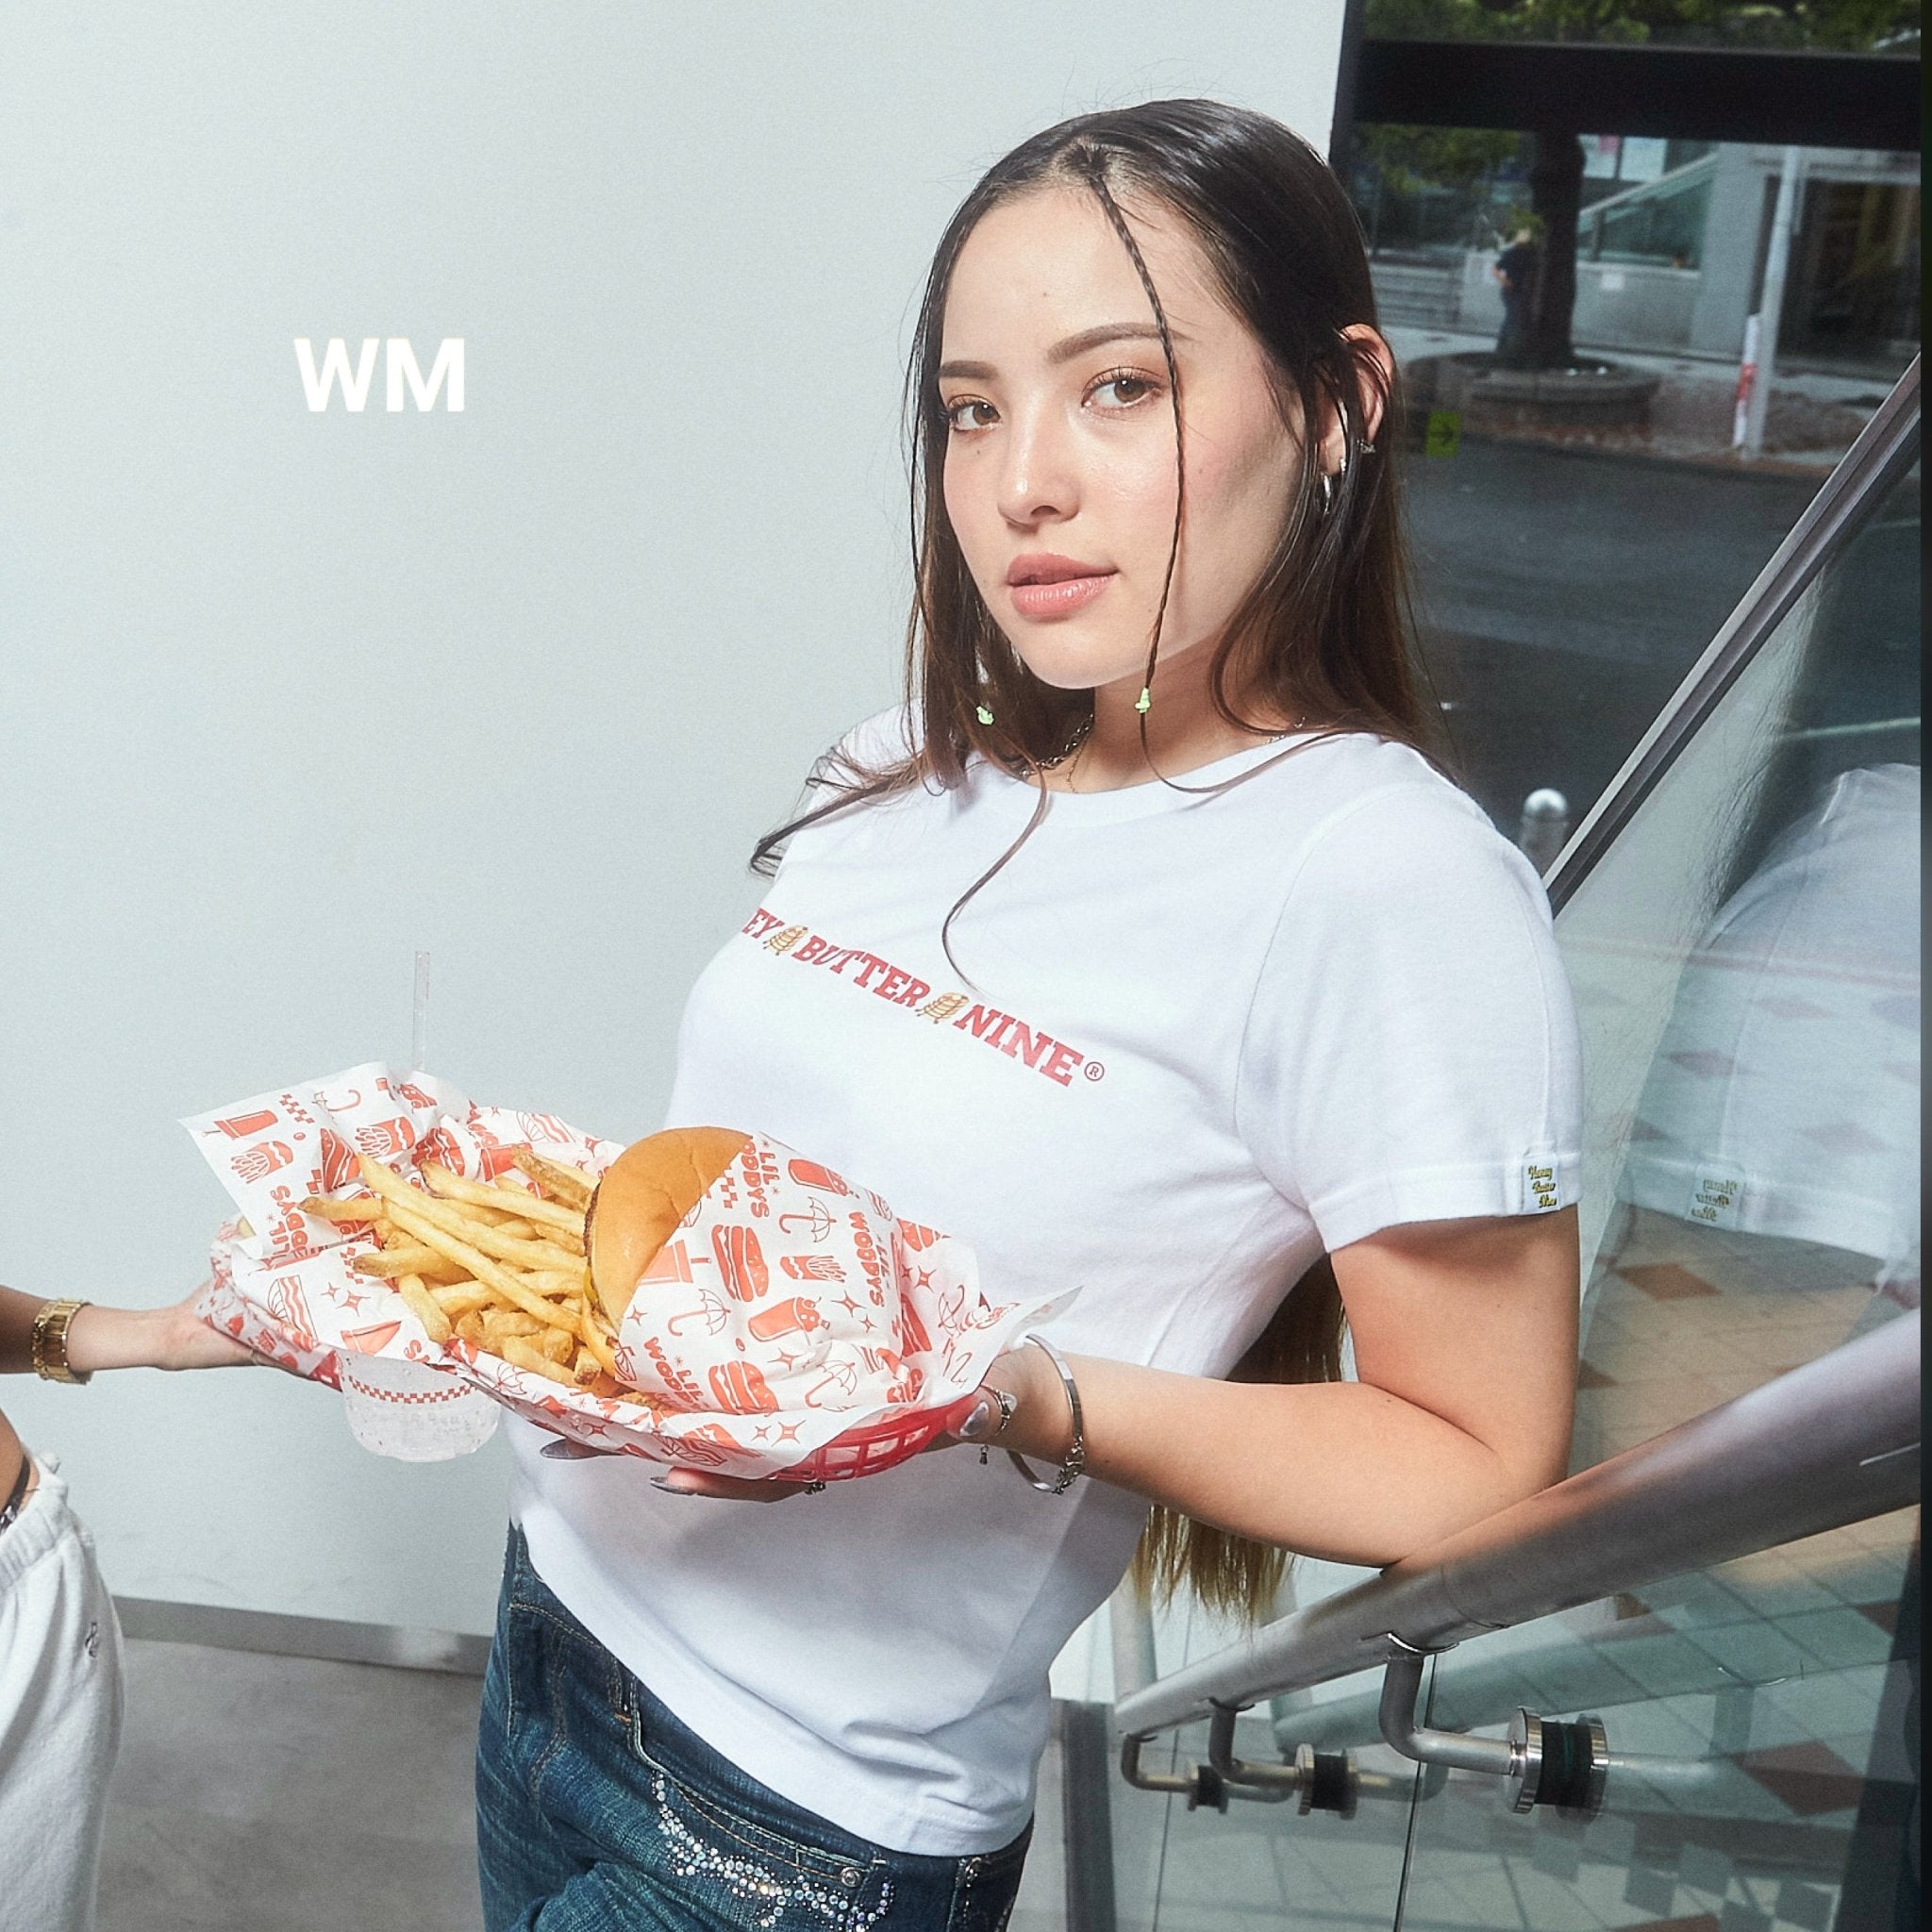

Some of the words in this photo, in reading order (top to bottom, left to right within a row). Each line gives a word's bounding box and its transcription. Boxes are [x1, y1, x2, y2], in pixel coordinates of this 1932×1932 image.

[791, 935, 931, 1008] BUTTER
[758, 1151, 780, 1186] LIL
[849, 1211, 885, 1307] WOODYS
[676, 1369, 704, 1402] LIL
